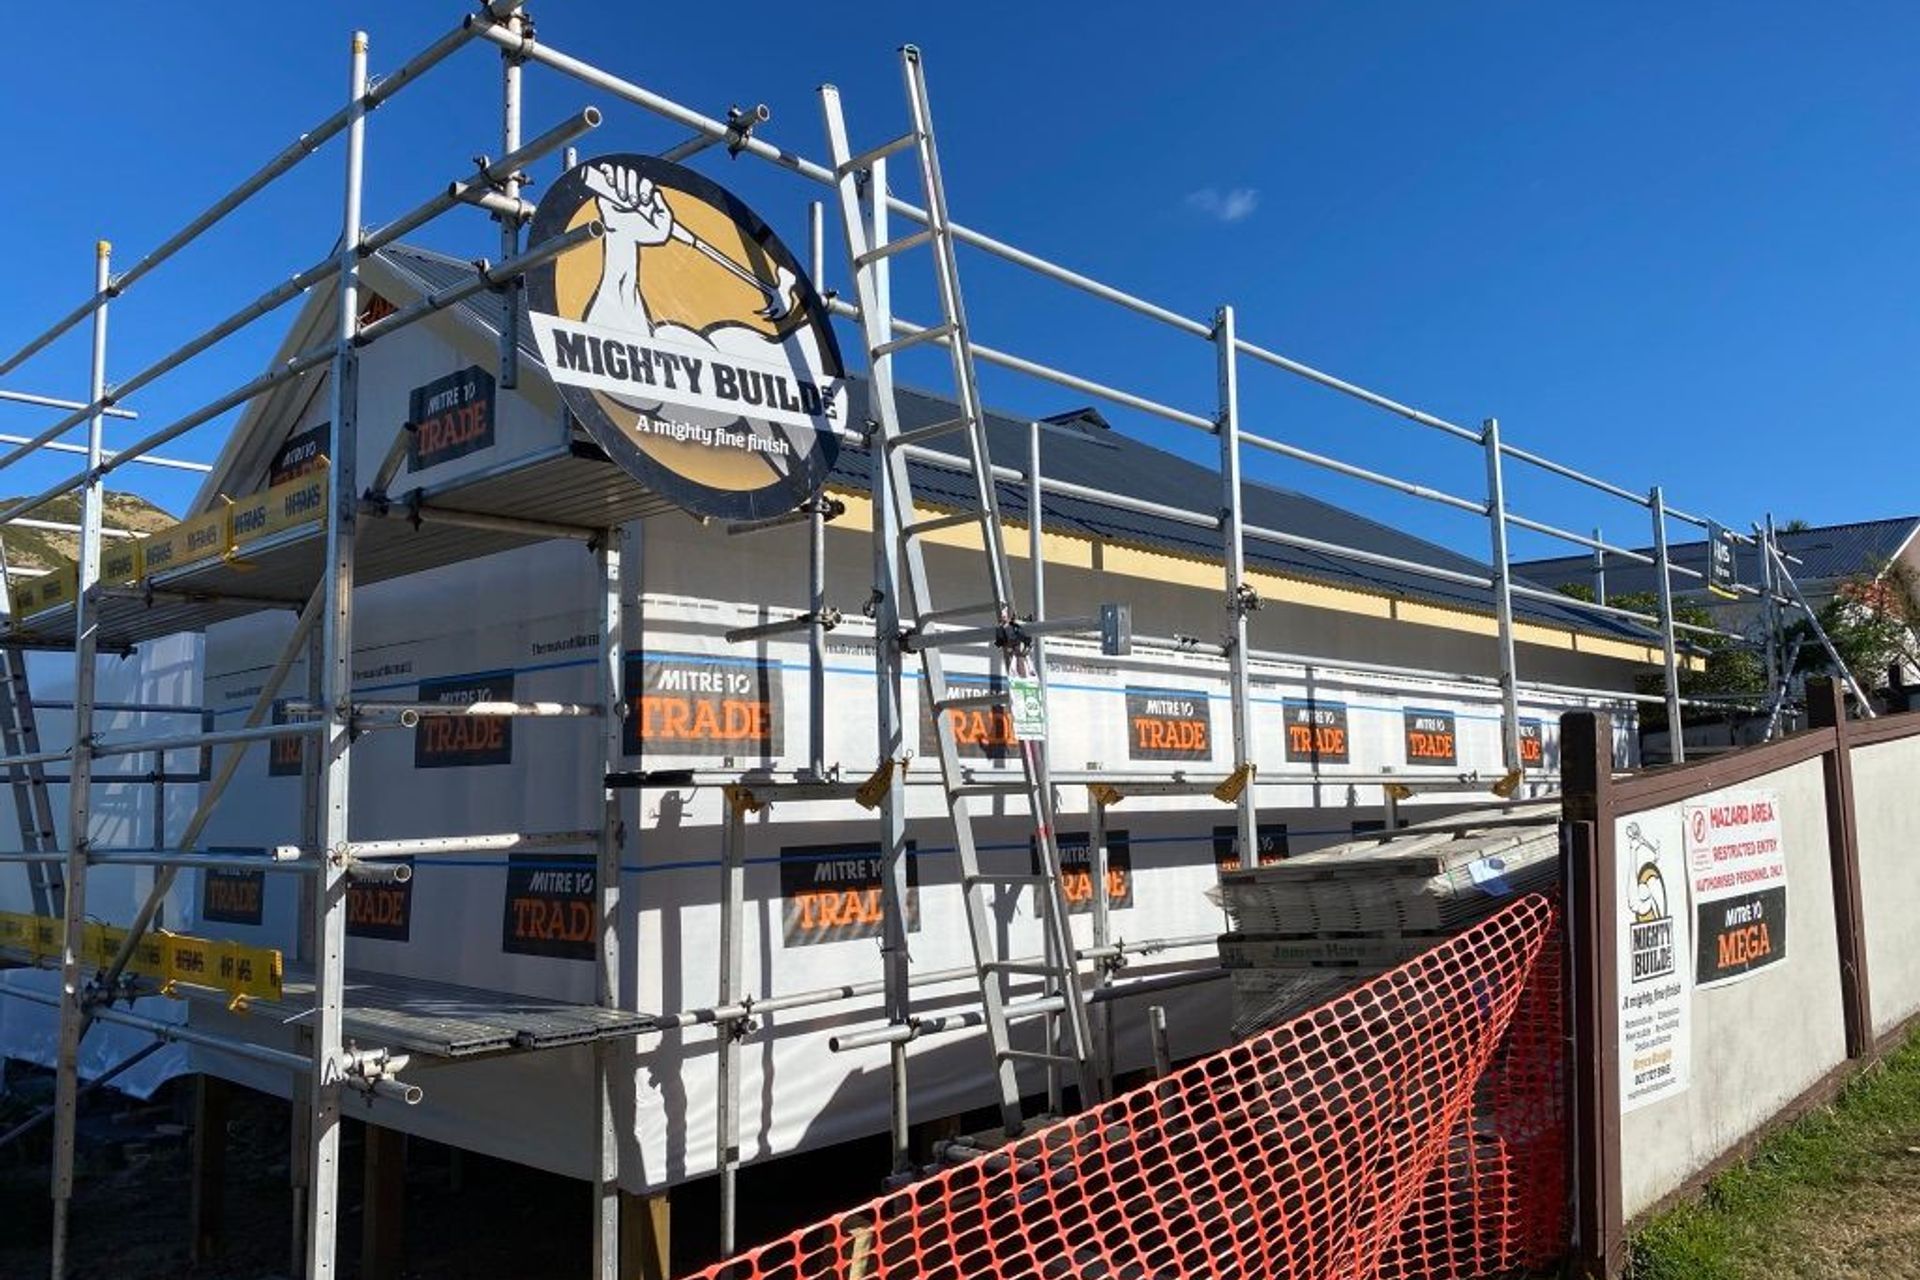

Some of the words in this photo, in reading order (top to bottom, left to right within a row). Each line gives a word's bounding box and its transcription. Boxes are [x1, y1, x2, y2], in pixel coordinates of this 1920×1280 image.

[552, 329, 702, 395] MIGHTY
[711, 362, 823, 416] BUILD
[427, 387, 459, 416] MITRE
[463, 382, 476, 401] 10
[418, 400, 487, 456] TRADE
[636, 414, 650, 432] A
[654, 420, 712, 445] mighty
[714, 428, 745, 447] fine
[747, 433, 789, 456] finish
[658, 670, 723, 693] MITRE
[727, 673, 750, 694] 10
[640, 696, 770, 739] TRADE
[1146, 700, 1179, 716] MITRE
[1181, 702, 1194, 717] 10
[424, 715, 504, 752] TRADE
[1134, 718, 1206, 750] TRADE
[1290, 726, 1345, 754] TRADE
[1409, 732, 1453, 757] TRADE
[1710, 804, 1749, 828] HAZARD
[1751, 801, 1775, 823] AREA
[1712, 841, 1756, 861] RESTRICTED
[529, 871, 572, 893] MITRE
[575, 873, 594, 894] 10
[814, 860, 867, 881] MITRE
[1725, 904, 1751, 928] MITRE
[1633, 922, 1672, 951] MIGHTY
[1717, 922, 1771, 969] MEGA
